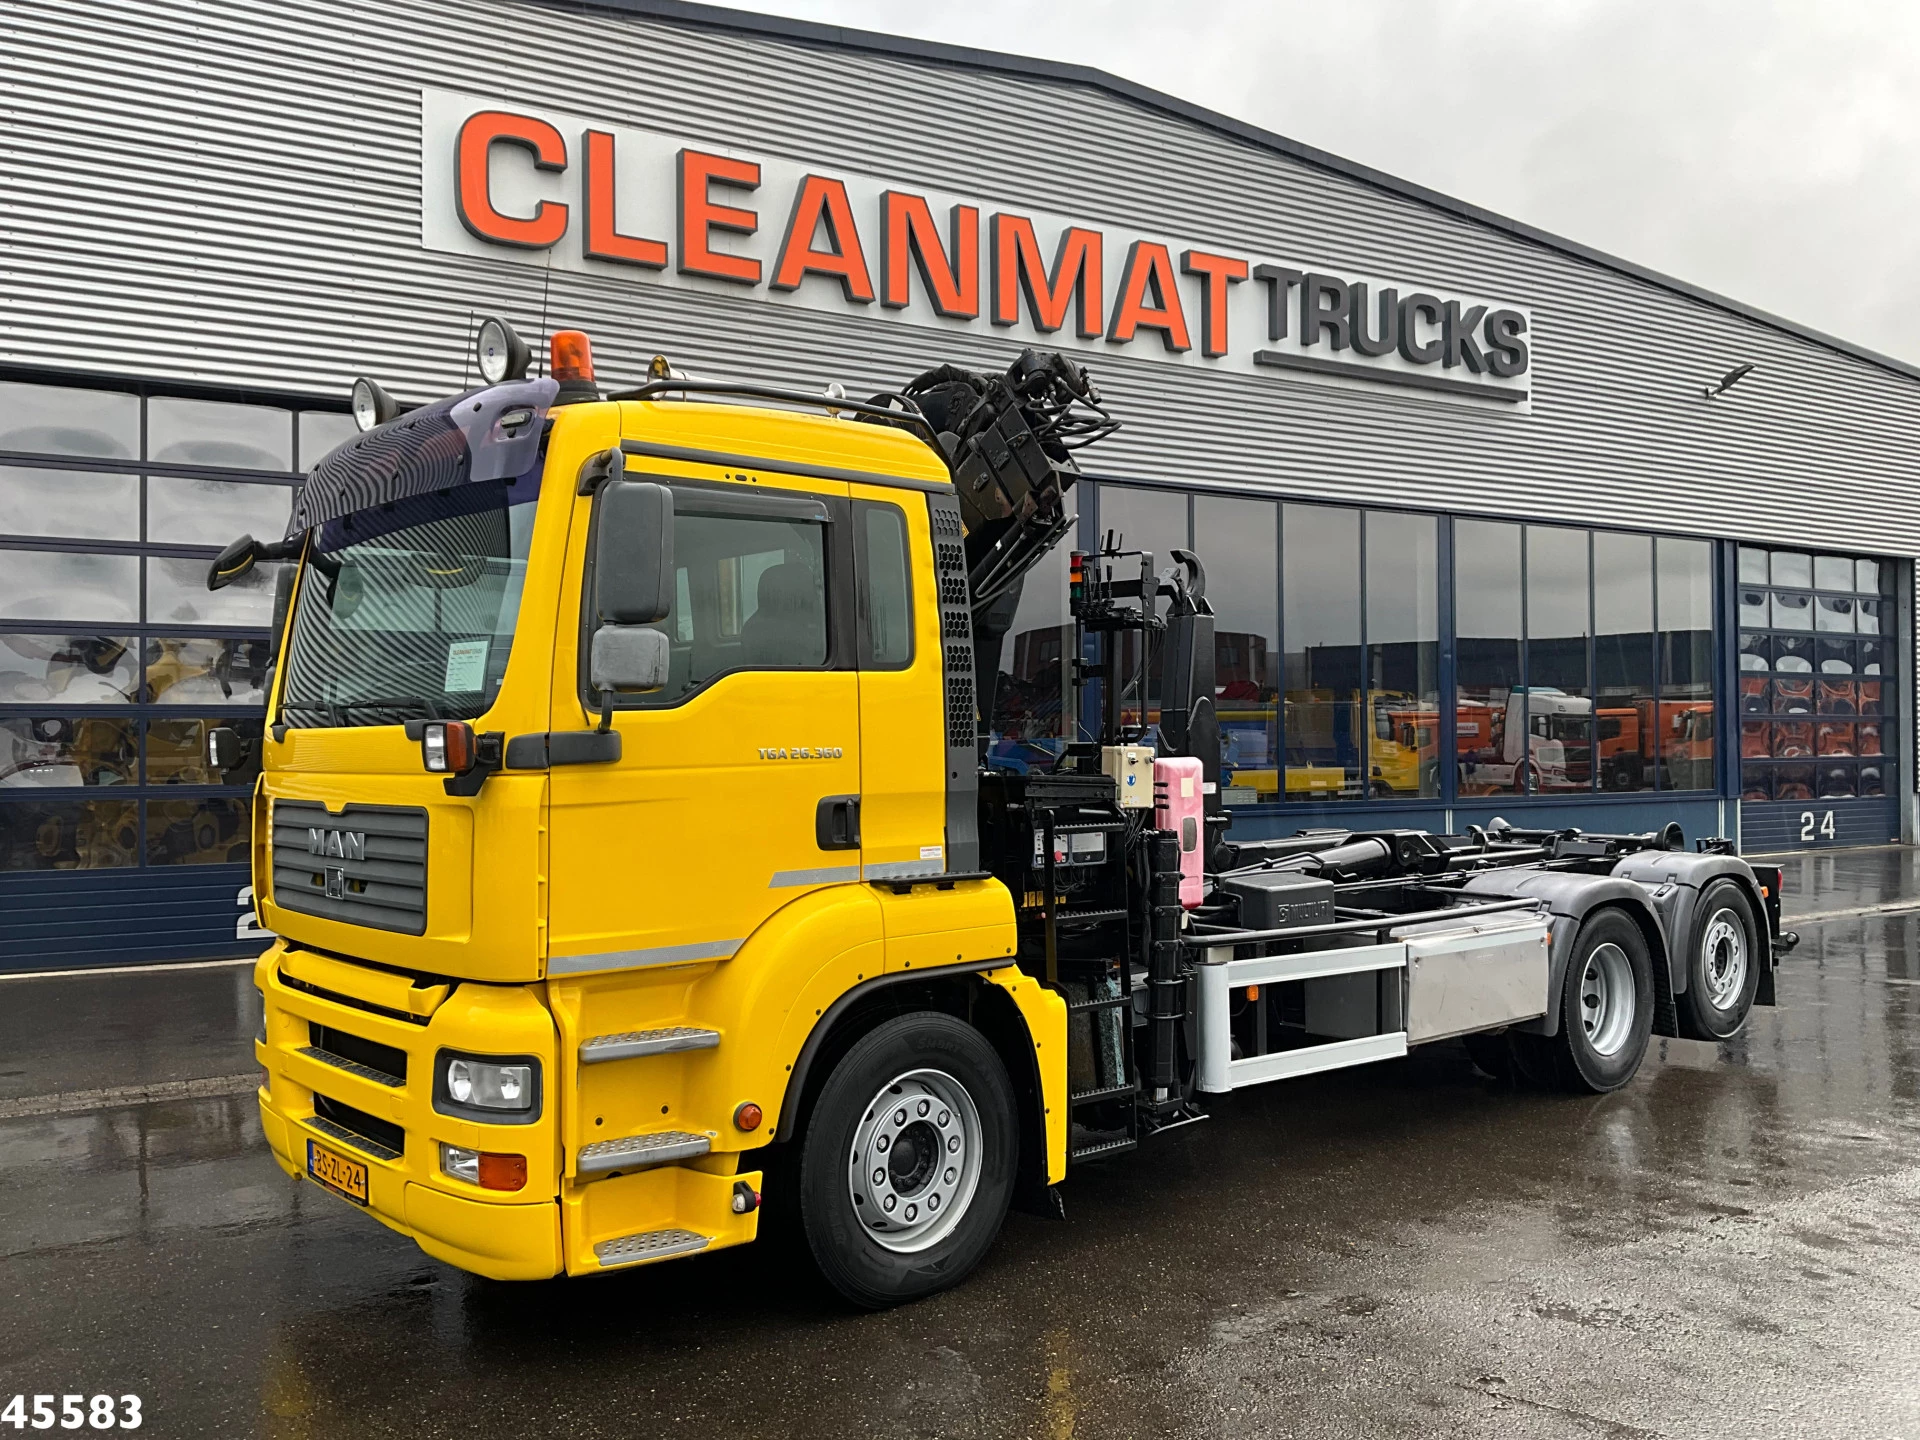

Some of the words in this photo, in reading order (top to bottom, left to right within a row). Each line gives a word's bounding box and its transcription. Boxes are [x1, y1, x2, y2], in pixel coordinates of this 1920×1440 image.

[453, 109, 1249, 358] CLEANMAT
[1254, 263, 1529, 377] TRUCKS
[758, 747, 787, 760] TGA
[790, 747, 843, 760] 26.360
[1800, 810, 1836, 841] 24
[308, 828, 365, 861] MAN
